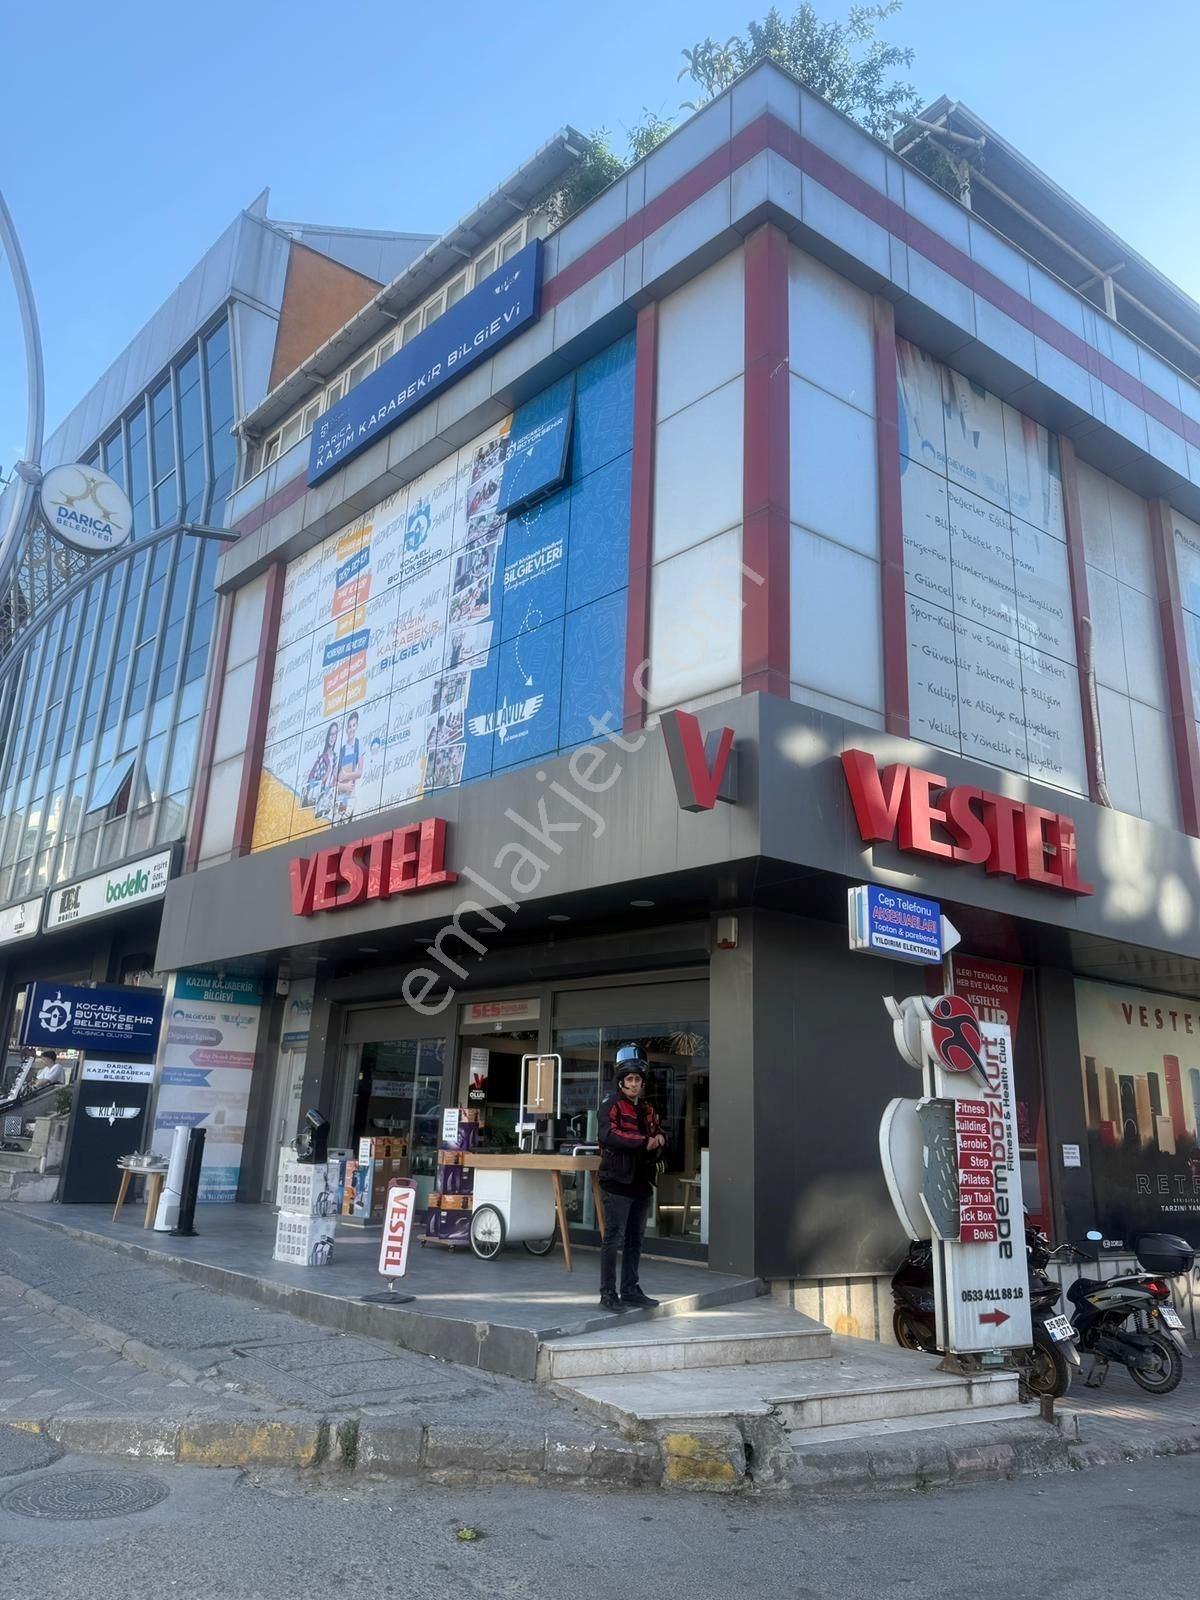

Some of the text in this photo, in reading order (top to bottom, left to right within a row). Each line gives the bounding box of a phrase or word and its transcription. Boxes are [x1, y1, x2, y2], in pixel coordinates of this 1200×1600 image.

[316, 431, 354, 469] KAZIM
[58, 506, 112, 536] DARICA
[935, 516, 959, 538] Bilgi
[961, 529, 993, 555] Destek
[914, 573, 953, 599] Güncel
[957, 594, 970, 605] ve
[972, 633, 984, 644] ve
[985, 635, 1011, 655] Sanat
[922, 644, 972, 672] Güvenilir
[975, 661, 1015, 685] İnternet
[1031, 685, 1062, 709] Bilişim
[927, 682, 957, 707] Kulüp
[960, 696, 973, 708] ve
[975, 700, 1006, 725] Atölye
[928, 717, 968, 742] Velilere
[970, 732, 1012, 757] Yönelik
[840, 747, 1094, 898] VESTEL
[289, 817, 458, 917] VESTEL
[106, 869, 148, 903] badella
[878, 893, 932, 917] Cep Telefonu
[874, 936, 902, 949] YILDIRIM
[971, 980, 983, 990] EVE
[1121, 1002, 1200, 1034] VESTE
[998, 1037, 1007, 1064] Club
[1000, 1067, 1010, 1108] Health
[970, 1155, 989, 1168] Step
[1005, 1125, 1014, 1172] Fitness
[962, 1173, 990, 1185] Pilates
[974, 1192, 991, 1203] Thai
[961, 1210, 992, 1221] ick Box
[384, 1191, 411, 1271] VESTEL
[973, 1228, 994, 1240] Boks
[961, 1287, 1024, 1302] 0533 411 88 16
[1046, 1320, 1057, 1331] 35
[1060, 1326, 1072, 1337] 071
